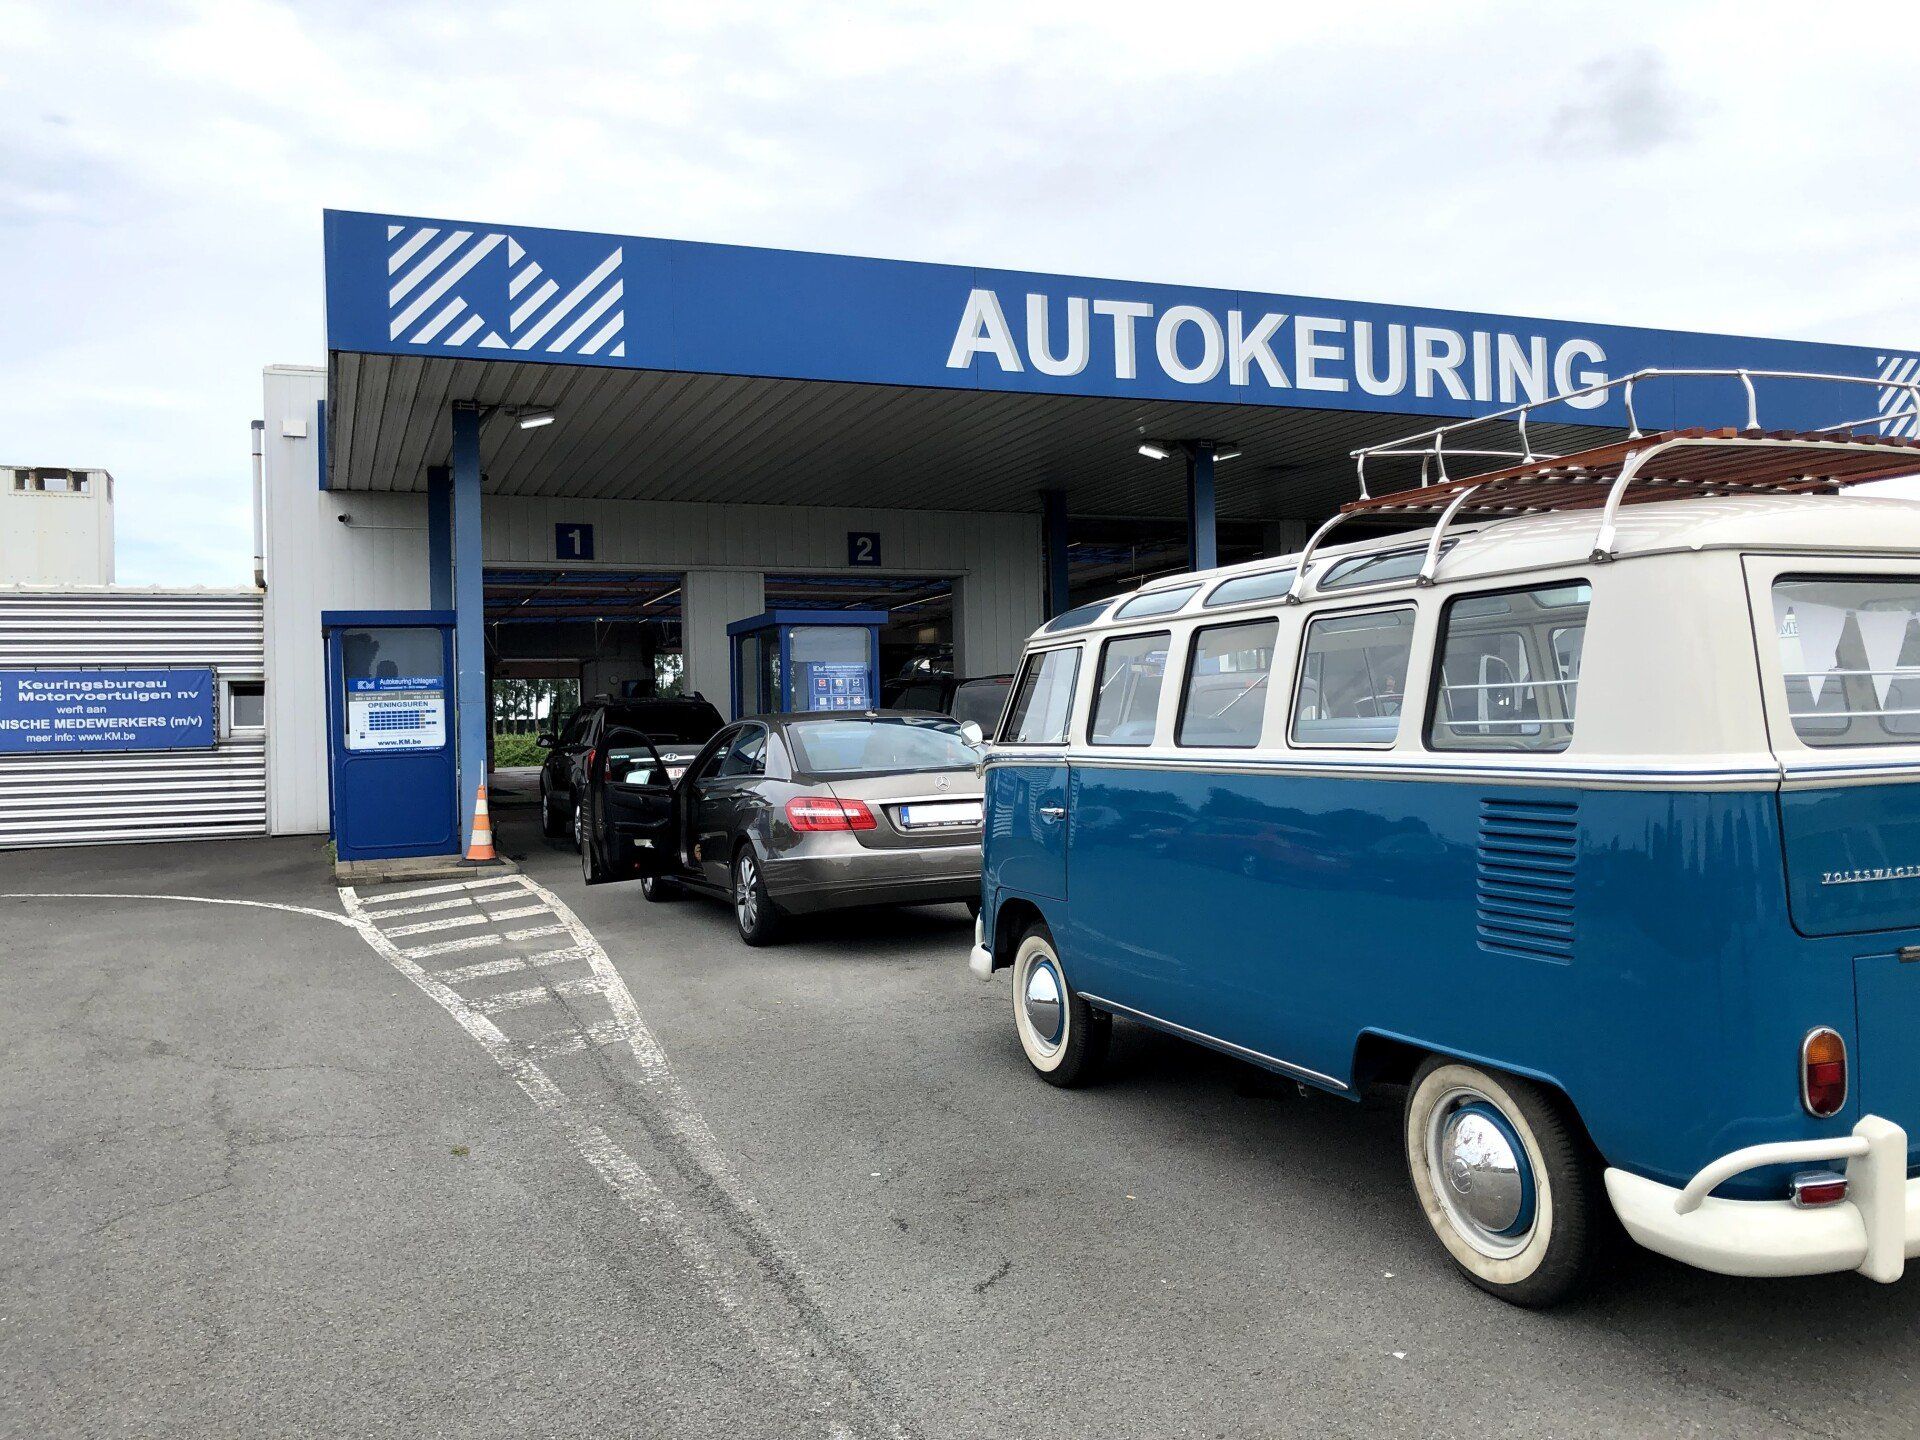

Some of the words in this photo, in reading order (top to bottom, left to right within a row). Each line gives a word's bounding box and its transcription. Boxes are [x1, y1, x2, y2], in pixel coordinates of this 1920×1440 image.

[946, 289, 1609, 410] AUTOKEURING
[568, 529, 581, 555] 1
[856, 537, 873, 561] 2
[18, 680, 167, 691] Keuringsbureau
[18, 691, 172, 702] Motorvoertuigen
[177, 691, 199, 699] nv
[56, 705, 84, 714] werft
[86, 706, 107, 714] aan
[368, 701, 429, 709] OPENINGSUREN
[54, 717, 167, 729] MEDEWERKERS
[170, 716, 203, 728] (m/v)
[26, 734, 53, 742] meer
[54, 733, 76, 742] info:
[78, 732, 136, 741] www.KM.be
